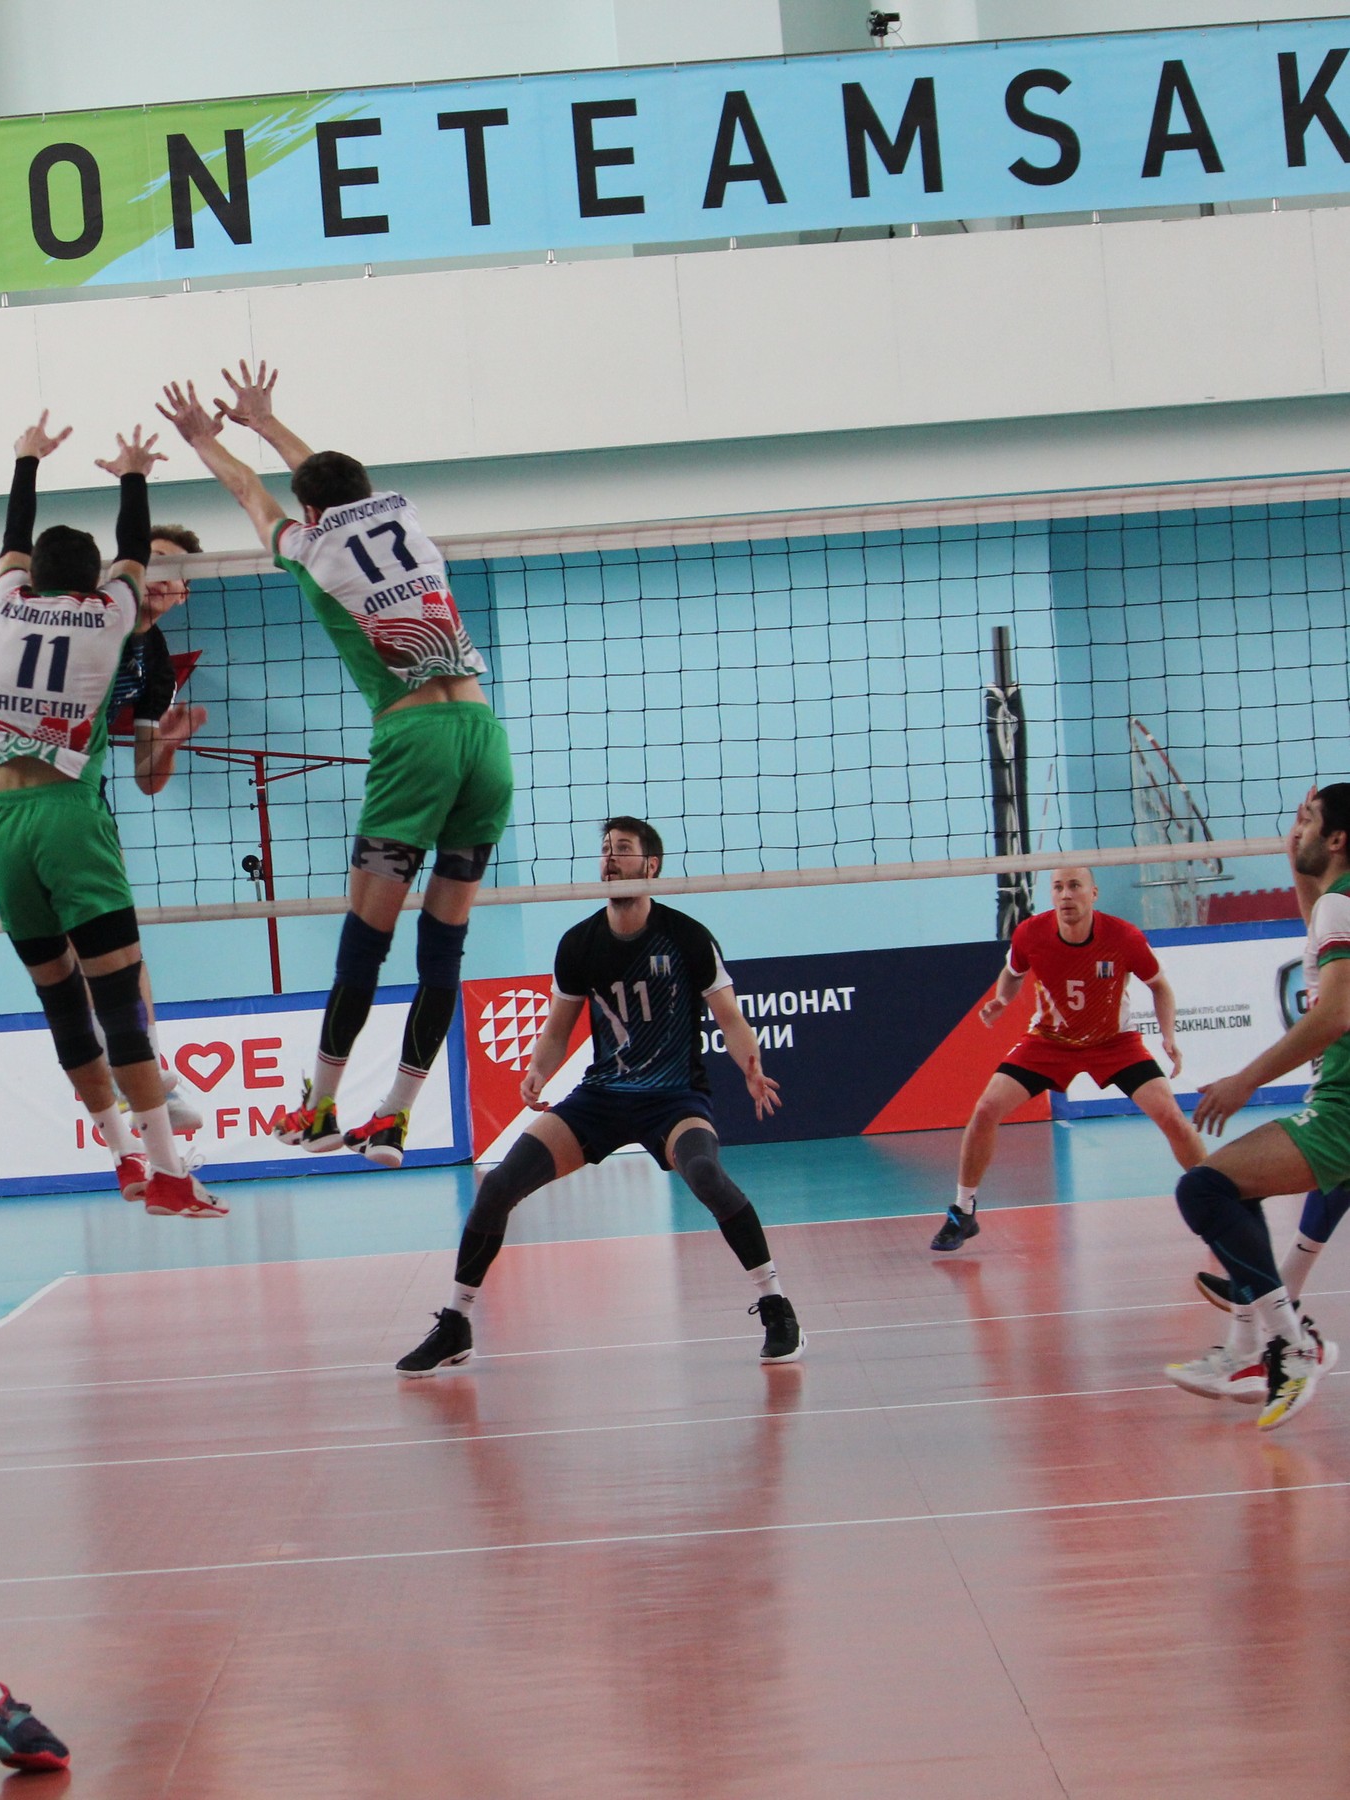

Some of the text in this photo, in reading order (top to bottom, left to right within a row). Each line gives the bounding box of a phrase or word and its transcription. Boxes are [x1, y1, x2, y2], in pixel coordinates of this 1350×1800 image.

[345, 520, 418, 584] 17
[363, 574, 444, 615] ДАГЕСТАН
[16, 633, 70, 693] 11
[610, 980, 652, 1023] 11
[701, 987, 856, 1022] ПИОНАТ
[1066, 979, 1085, 1011] 5
[216, 1105, 287, 1139] FM
